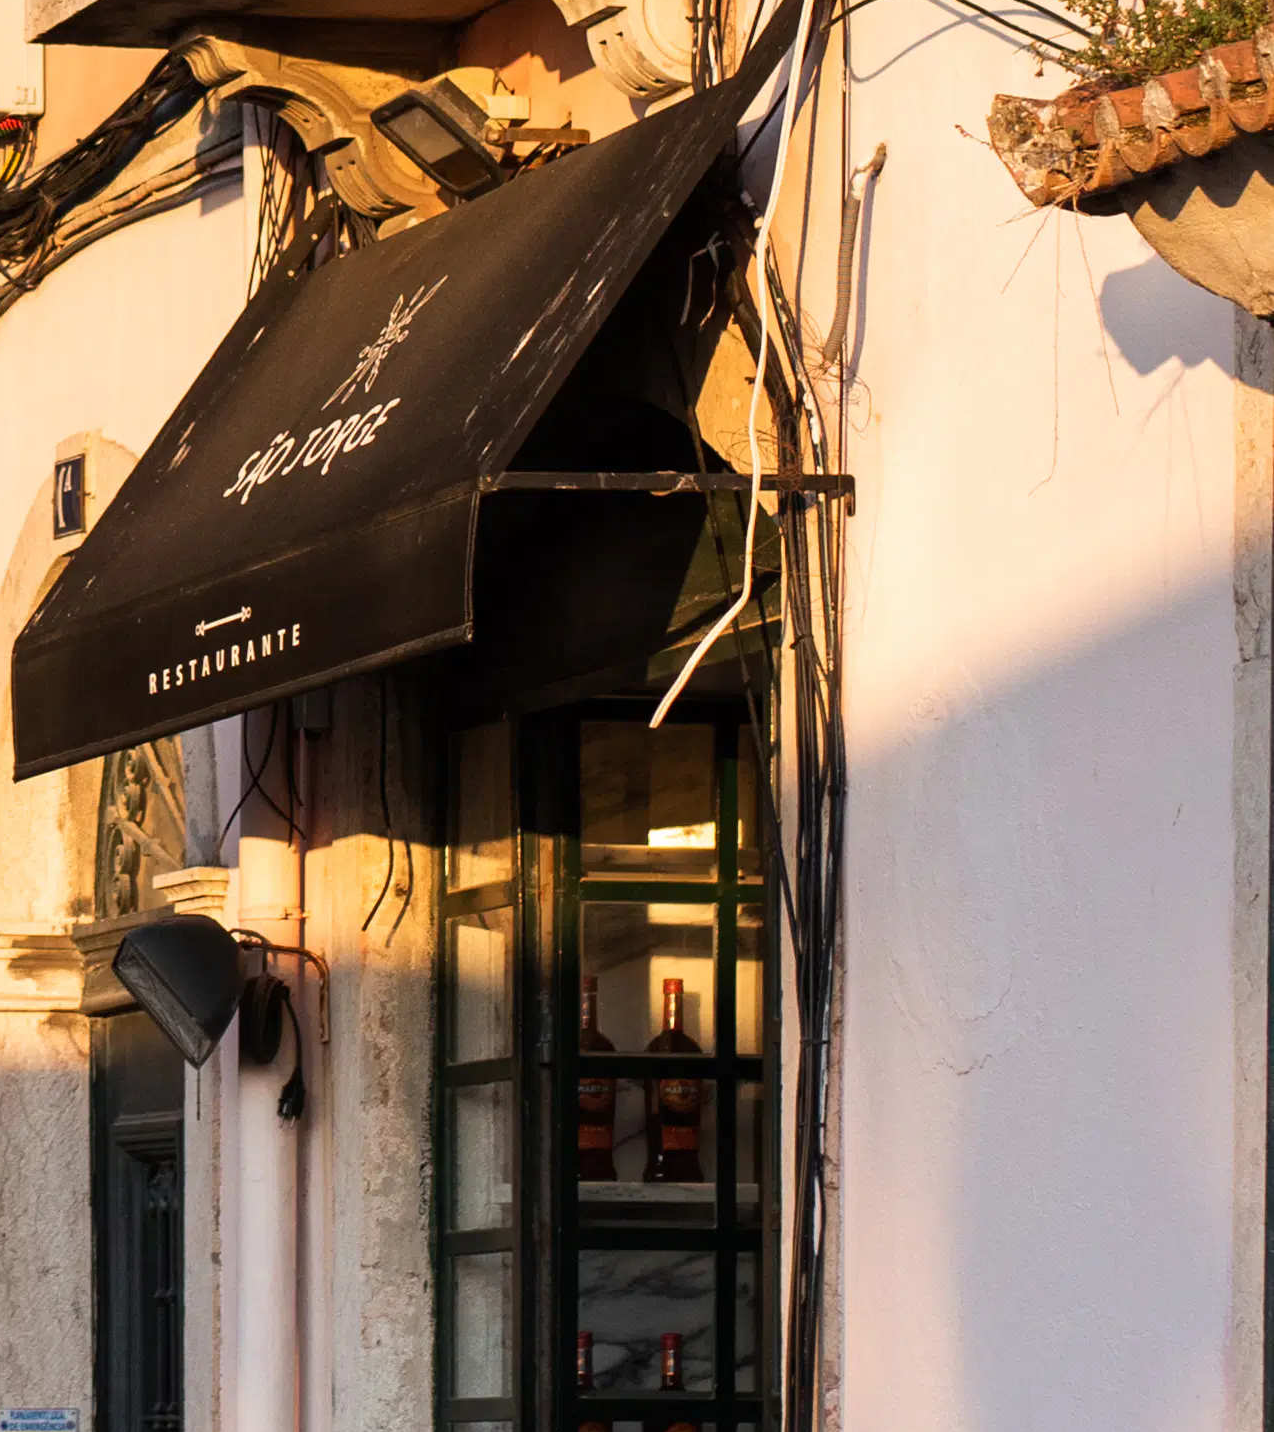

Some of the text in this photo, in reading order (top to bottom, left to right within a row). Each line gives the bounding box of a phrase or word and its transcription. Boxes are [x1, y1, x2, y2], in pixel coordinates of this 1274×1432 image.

[223, 397, 401, 505] SÃO JORGE
[148, 623, 301, 695] RESTAURANTE
